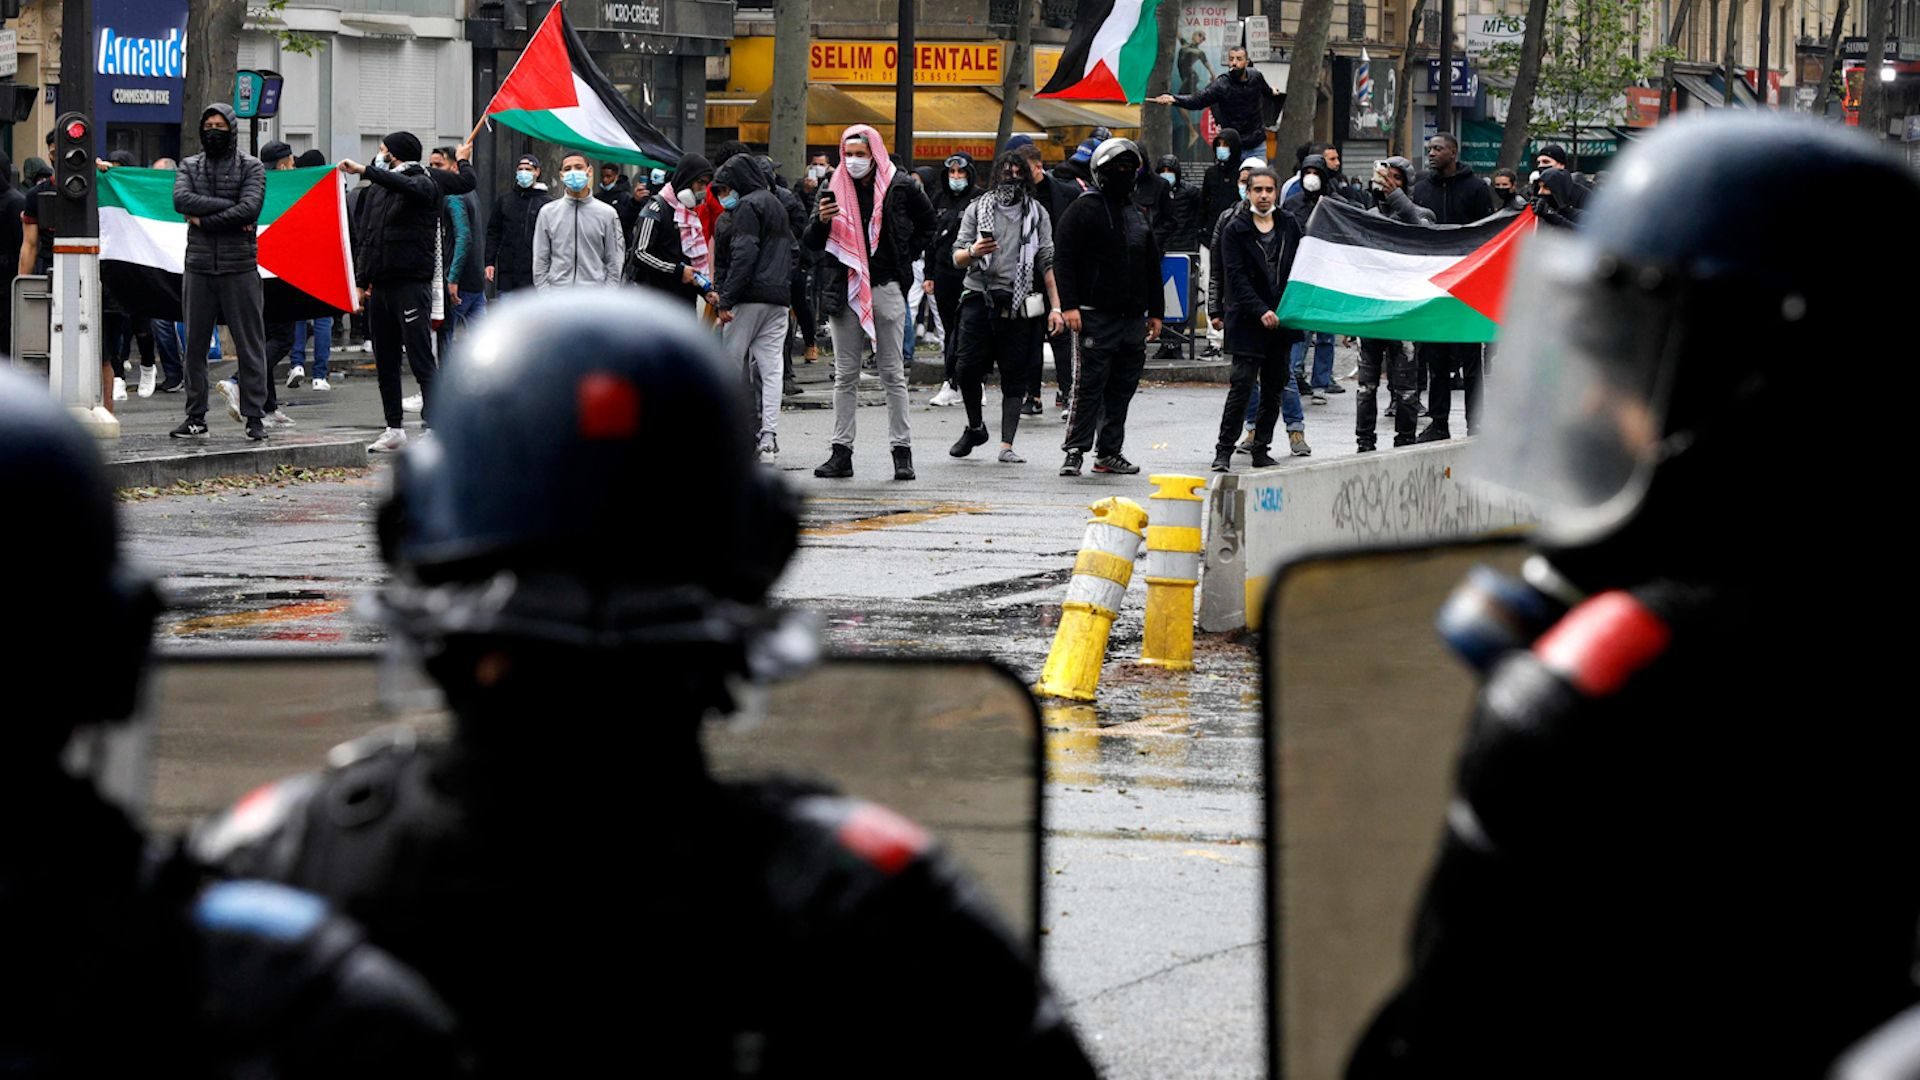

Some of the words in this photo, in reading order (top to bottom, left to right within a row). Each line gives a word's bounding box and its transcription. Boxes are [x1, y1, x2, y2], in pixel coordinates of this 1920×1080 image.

[1185, 7, 1196, 16] SI
[1200, 7, 1228, 16] TOUT
[1185, 17, 1200, 26] VA
[1203, 17, 1227, 27] BIEN
[98, 27, 187, 78] Arnaud
[811, 45, 872, 69] SELIM
[884, 46, 997, 70] OIENTALE
[112, 88, 154, 104] COMMISSION
